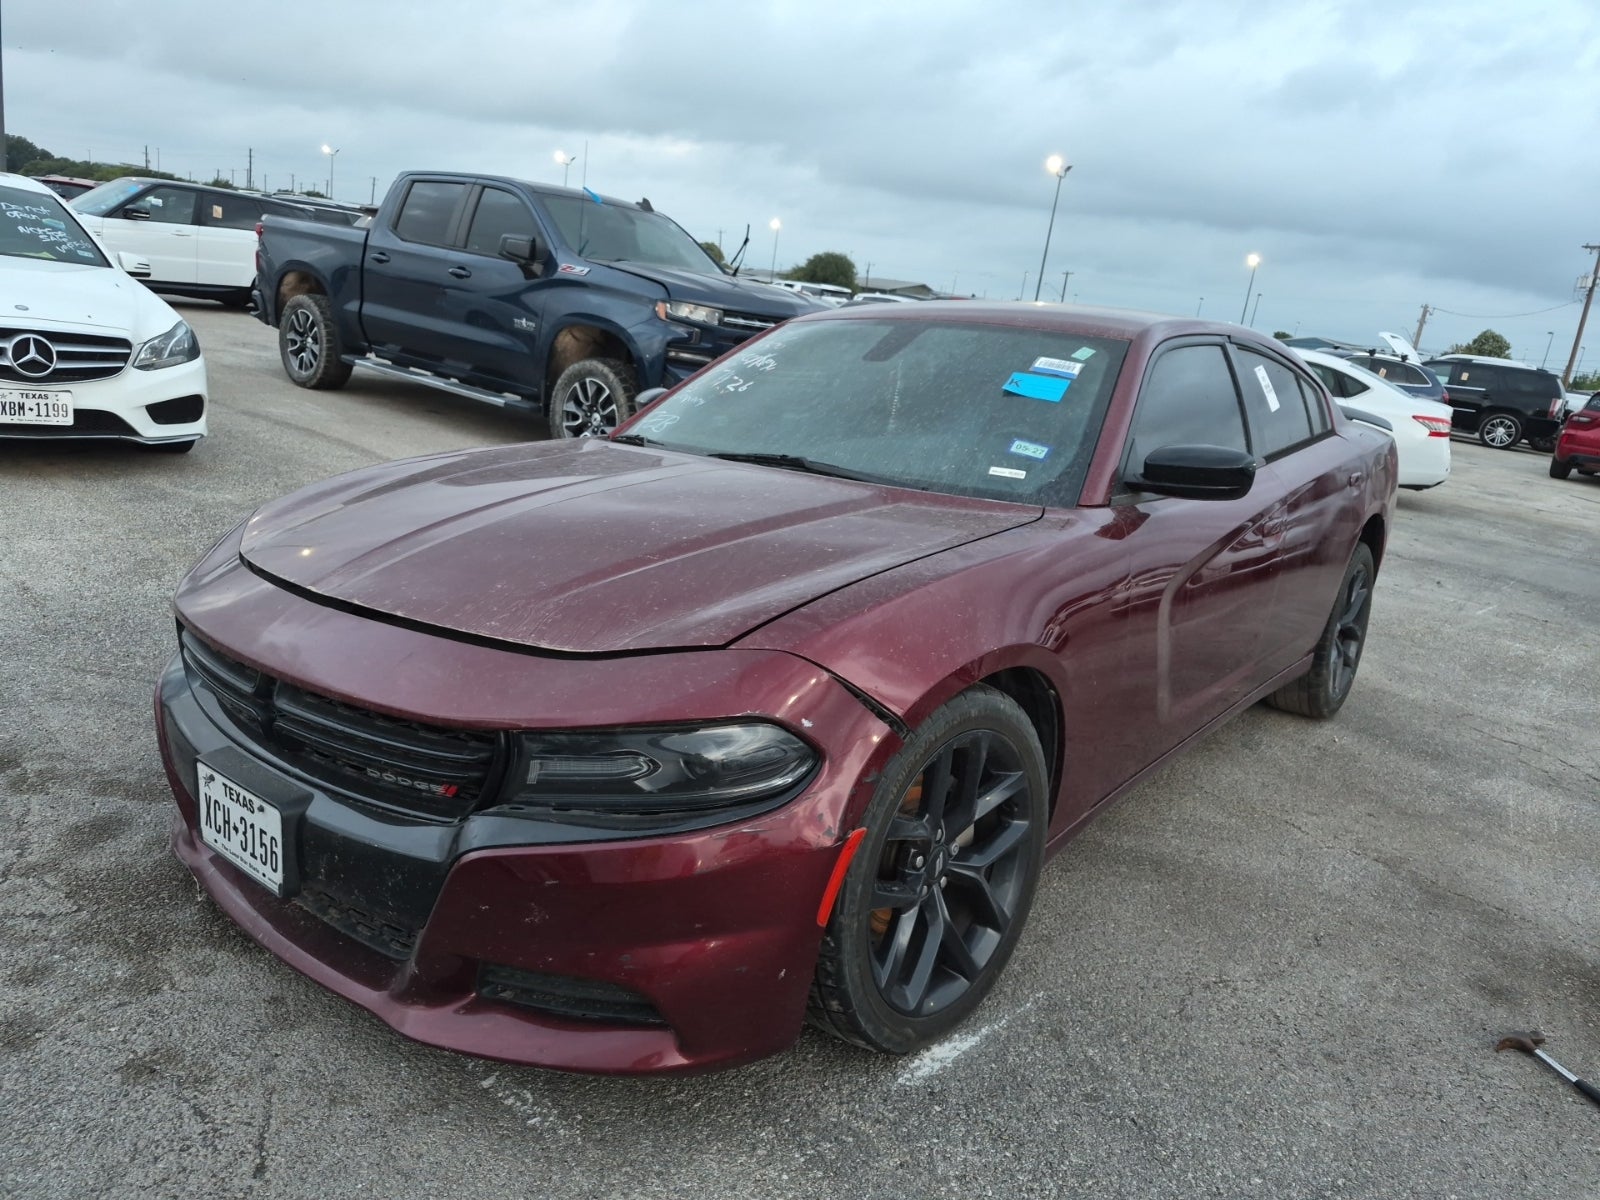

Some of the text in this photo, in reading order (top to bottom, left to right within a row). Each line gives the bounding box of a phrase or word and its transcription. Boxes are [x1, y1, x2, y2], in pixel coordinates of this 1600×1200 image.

[19, 392, 49, 400] TEXAS
[35, 402, 69, 418] 1199
[366, 767, 447, 793] DODGE
[222, 782, 255, 815] TEXAS
[240, 816, 278, 874] 3156
